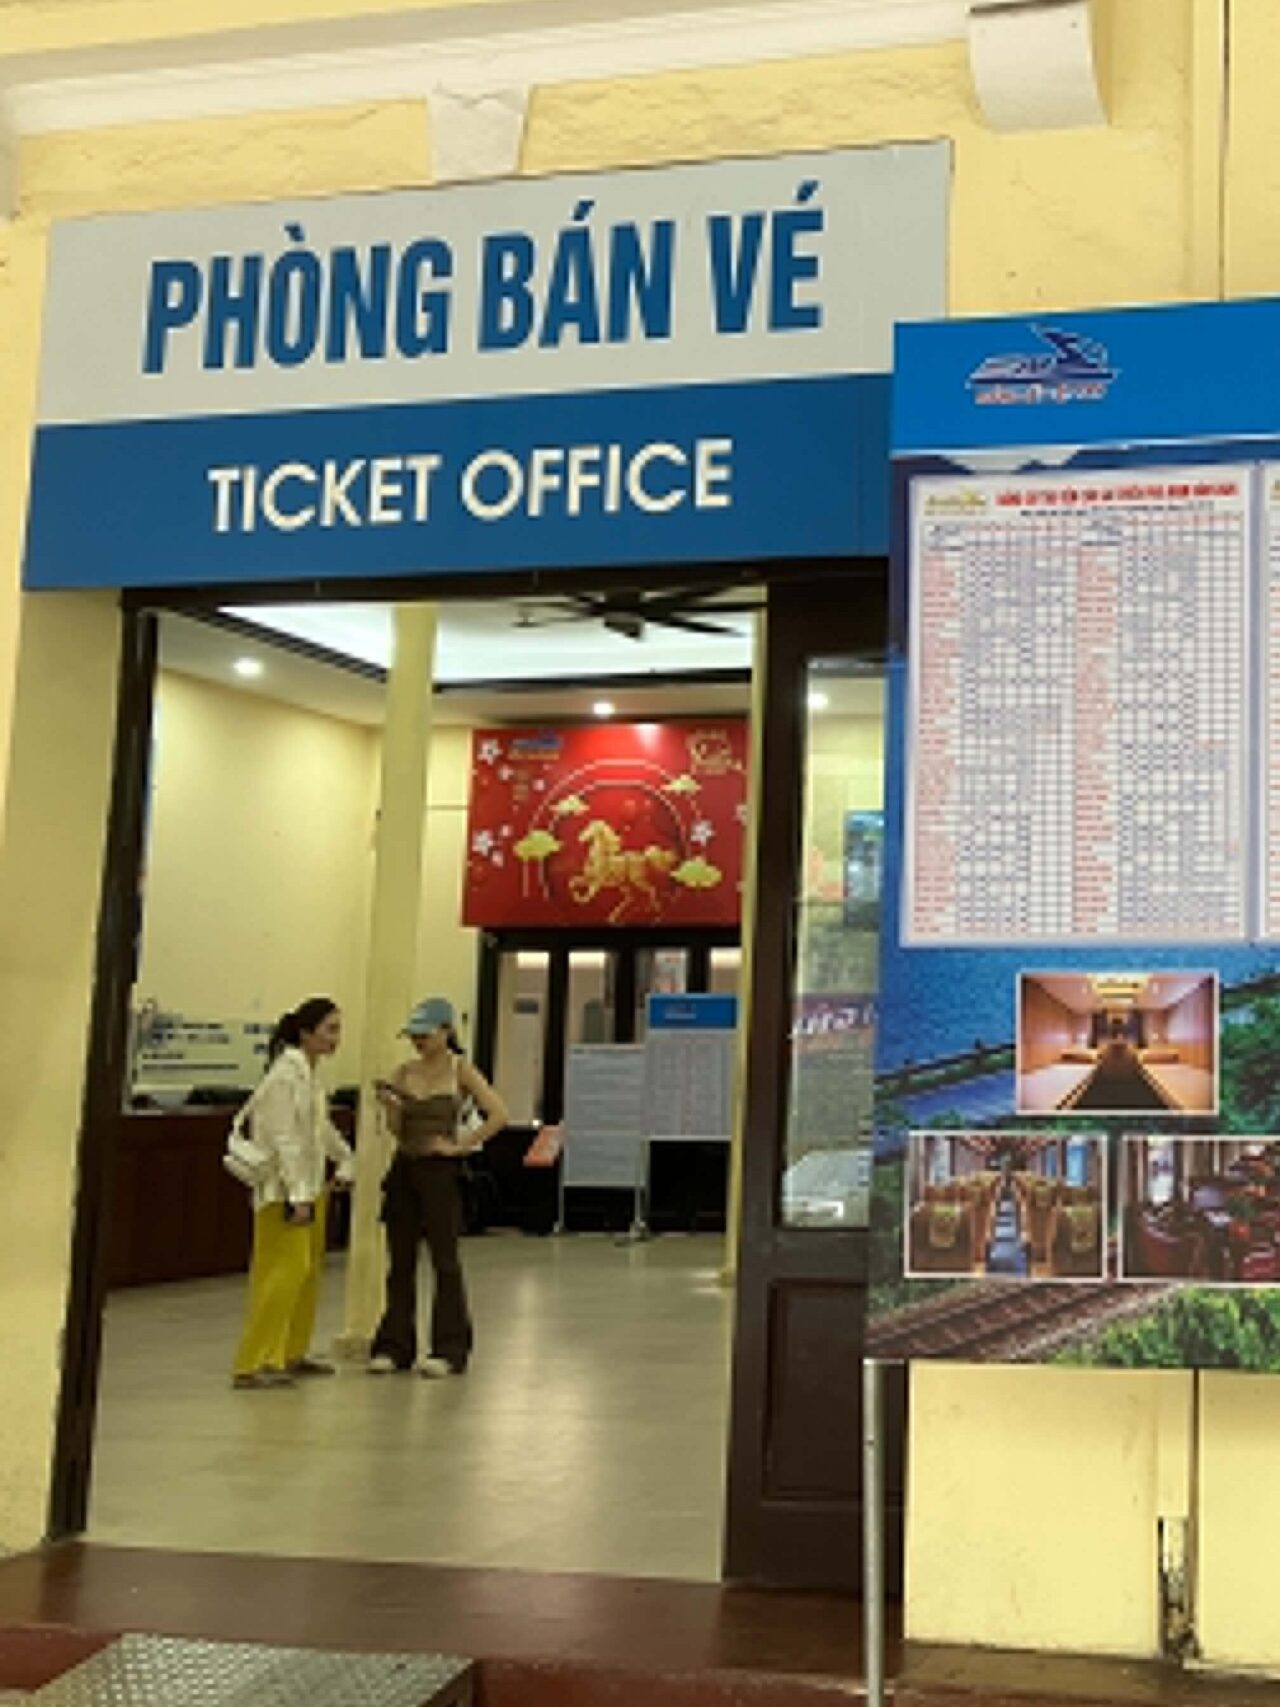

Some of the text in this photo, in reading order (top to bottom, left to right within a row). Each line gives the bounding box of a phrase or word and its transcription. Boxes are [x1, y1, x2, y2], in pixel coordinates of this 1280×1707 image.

[143, 180, 825, 374] PHÒNG BÁN VÉ
[207, 437, 734, 534] TICKET OFFICE
